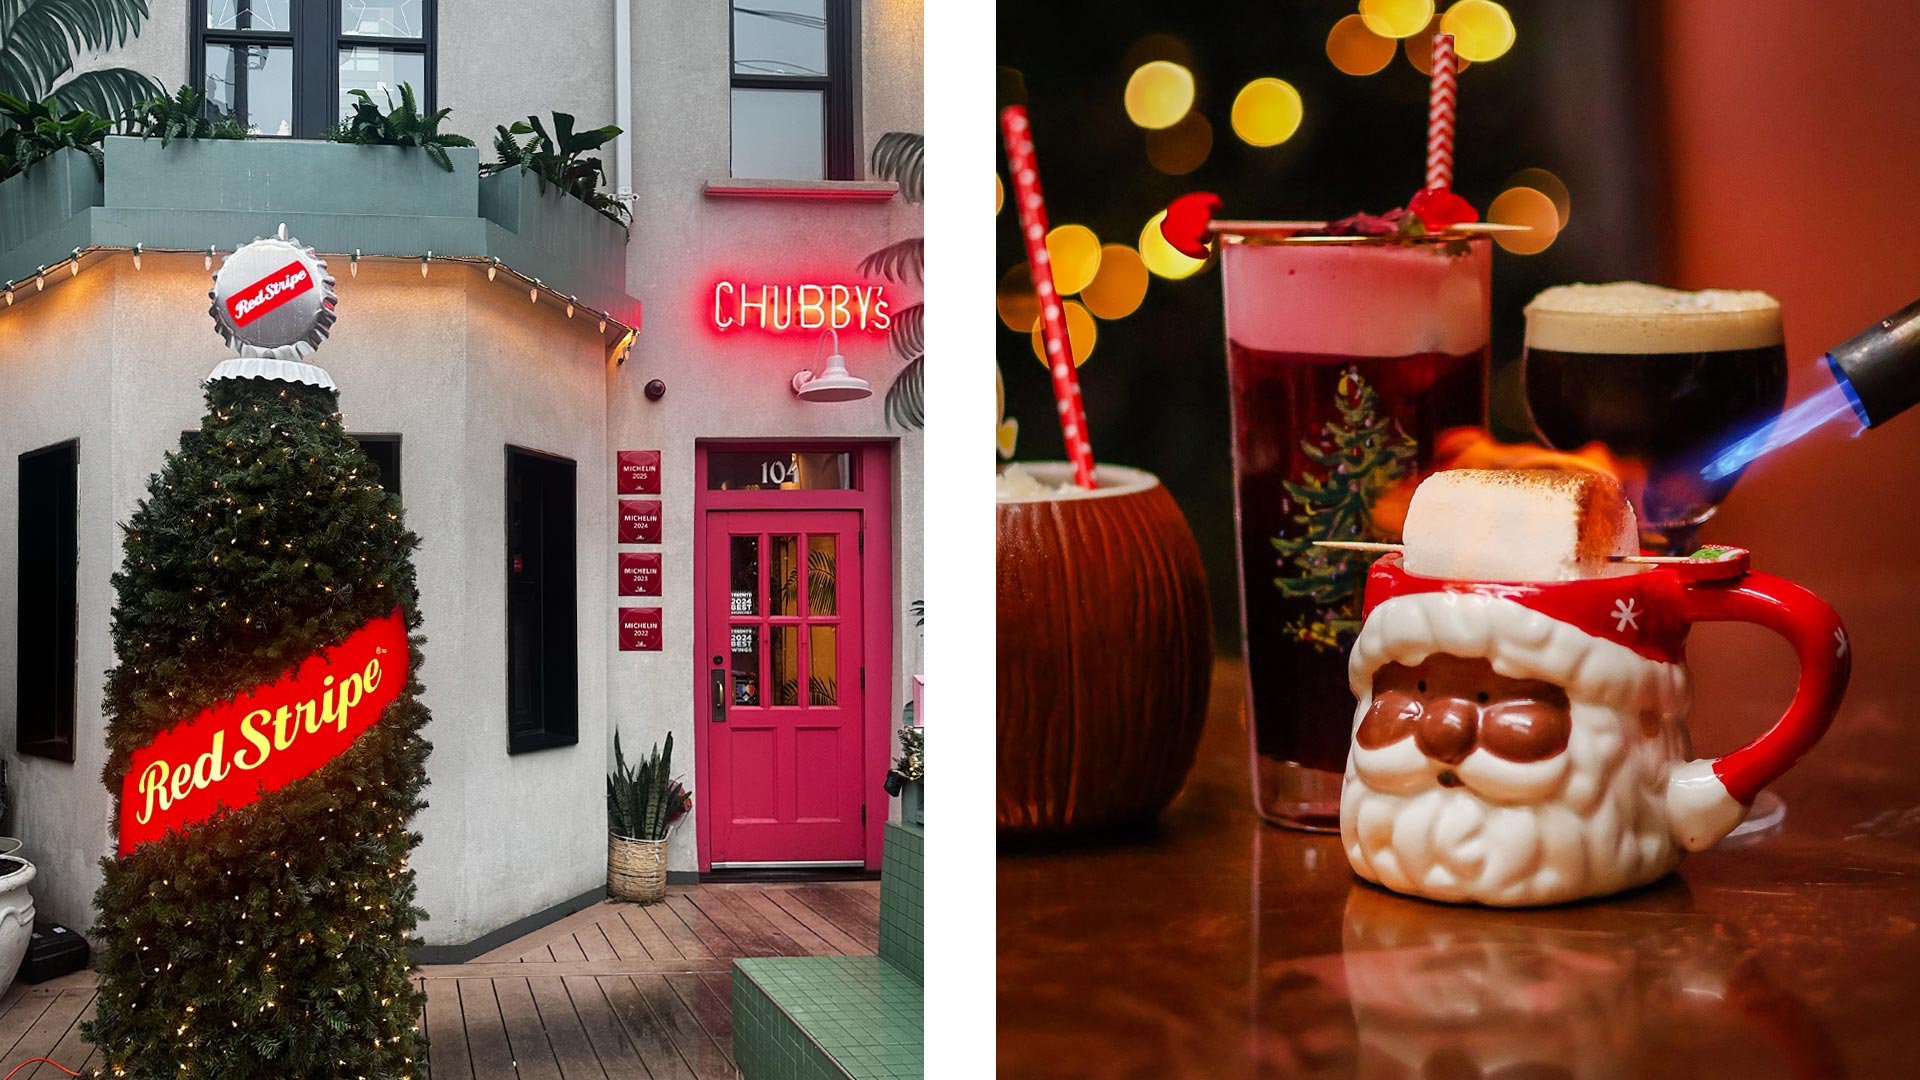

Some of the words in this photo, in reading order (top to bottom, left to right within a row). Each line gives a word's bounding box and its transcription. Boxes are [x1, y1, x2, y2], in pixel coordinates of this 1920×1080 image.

[235, 289, 265, 319] Red
[263, 269, 306, 301] Stripe
[761, 461, 799, 483] 104
[136, 730, 231, 825] Red
[233, 658, 382, 770] Stripe
